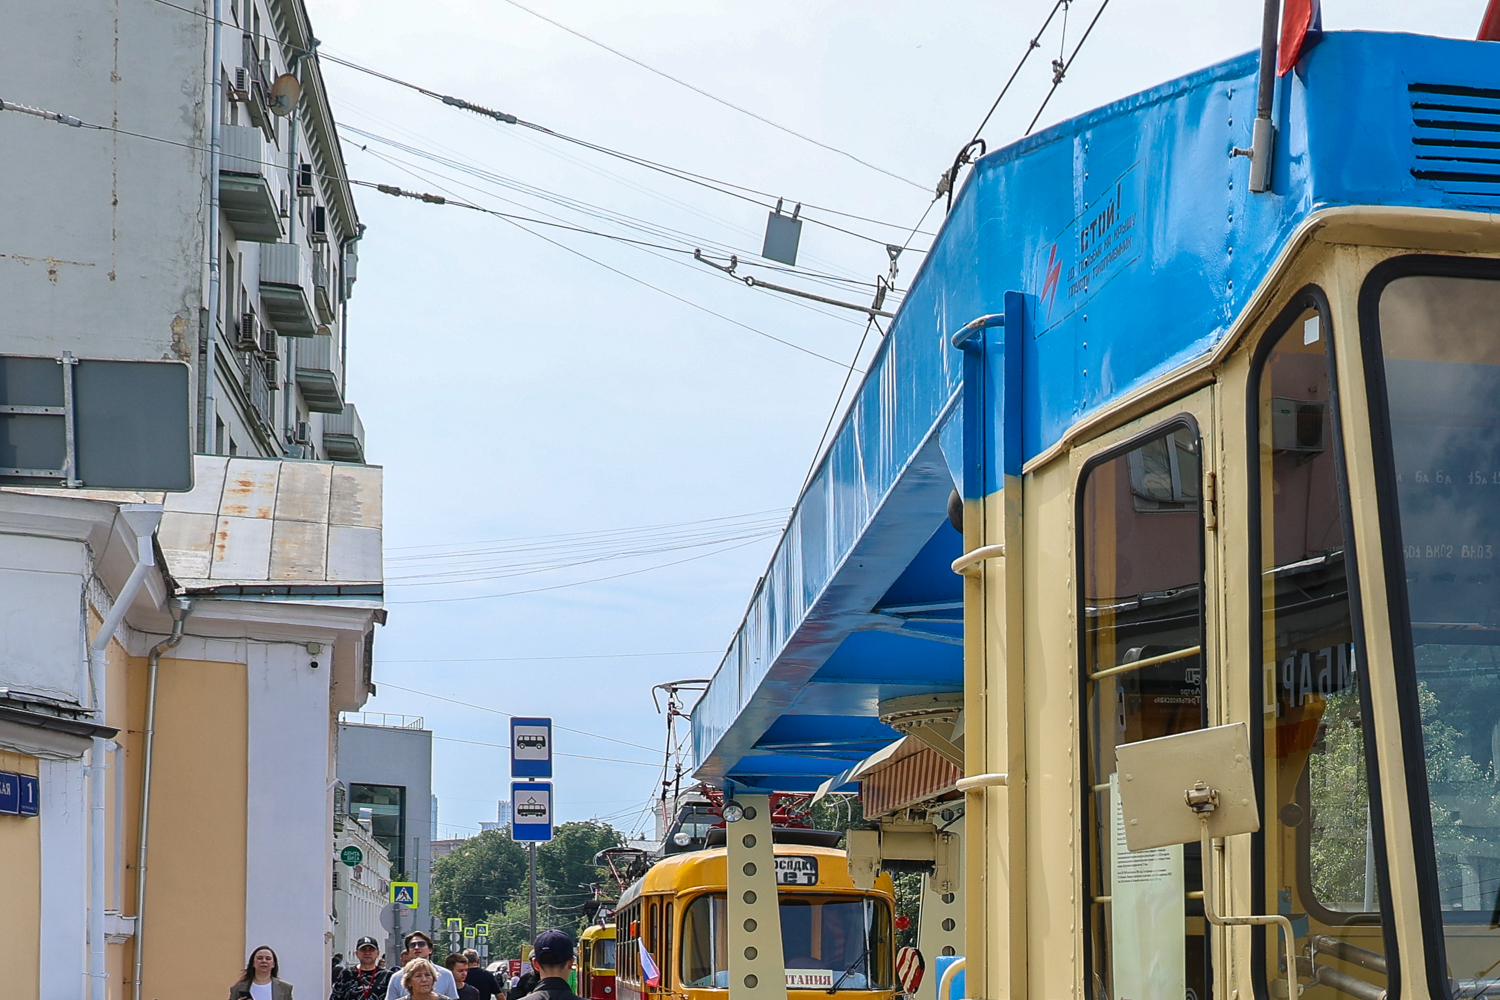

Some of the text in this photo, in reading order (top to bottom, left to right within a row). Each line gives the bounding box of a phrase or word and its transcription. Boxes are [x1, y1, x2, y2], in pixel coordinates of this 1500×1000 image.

[1080, 183, 1121, 254] СТОЙ!
[0, 782, 33, 803] АЯ 1
